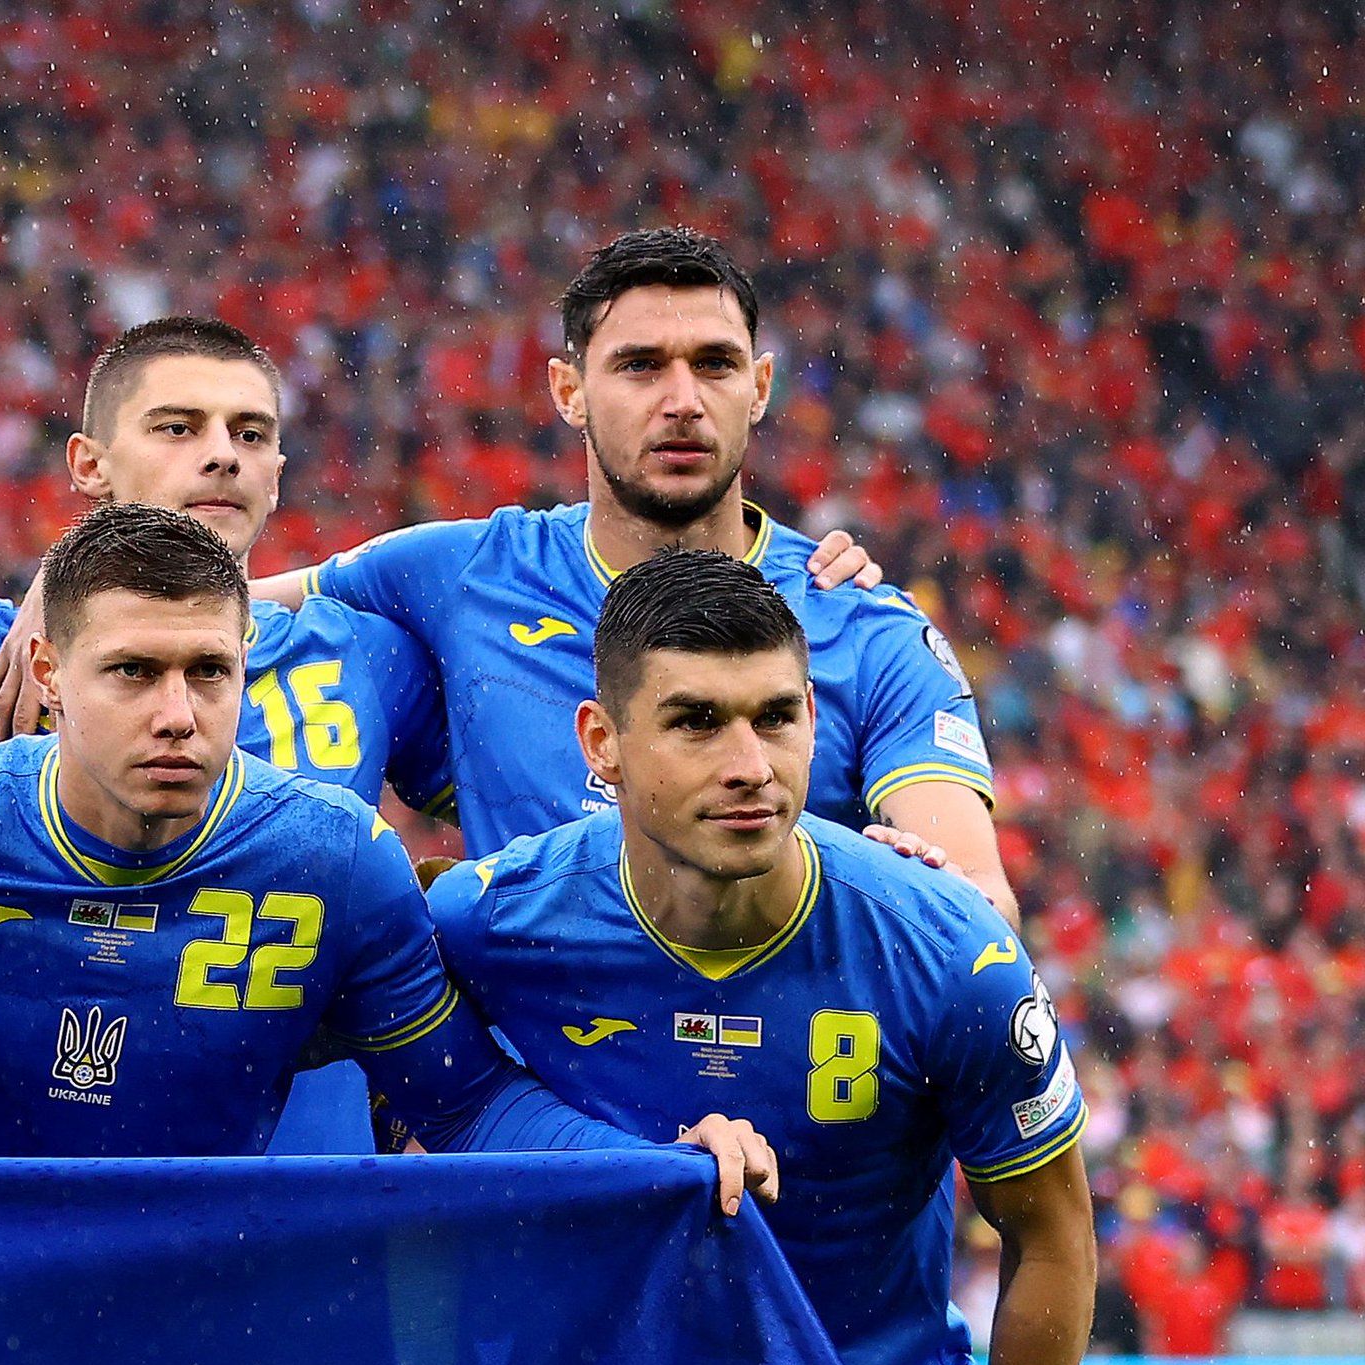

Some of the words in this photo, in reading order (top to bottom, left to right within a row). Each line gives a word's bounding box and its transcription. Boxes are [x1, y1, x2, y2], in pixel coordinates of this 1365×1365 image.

[246, 659, 361, 770] 16
[174, 887, 325, 1011] 22
[48, 1087, 112, 1105] UKRAINE
[806, 1009, 881, 1124] 8
